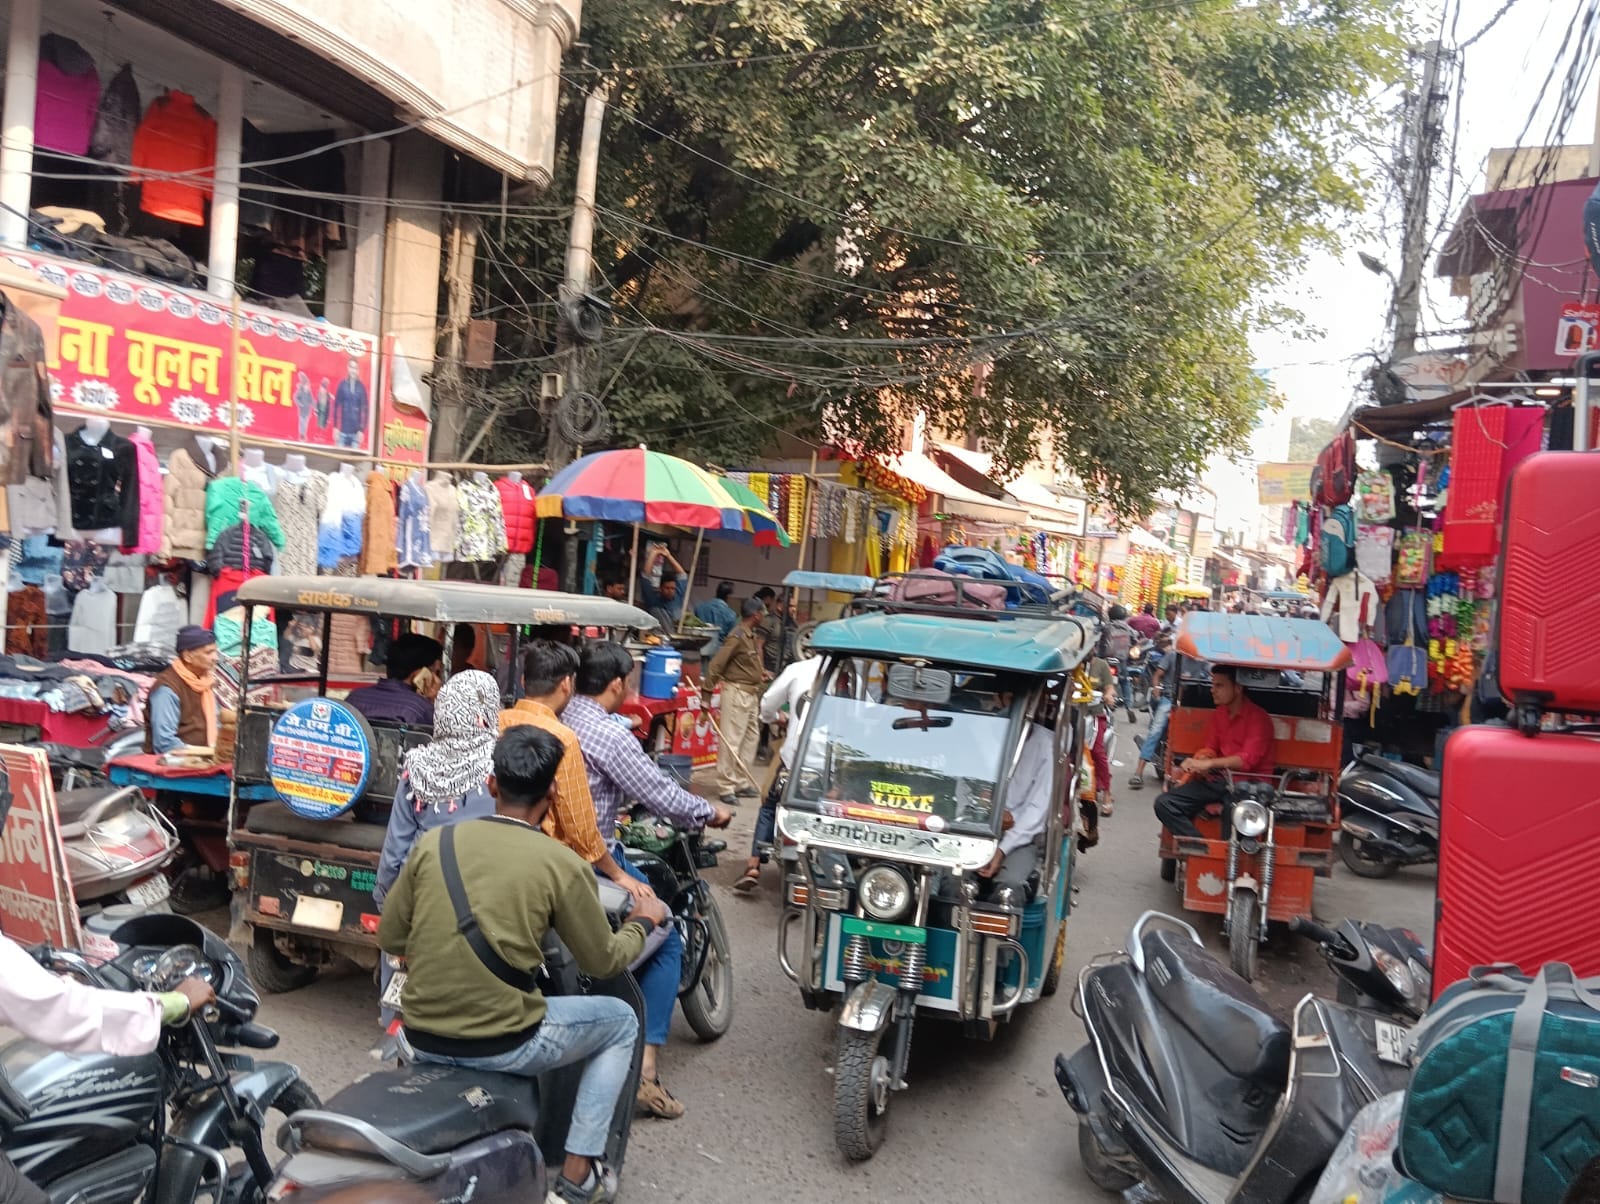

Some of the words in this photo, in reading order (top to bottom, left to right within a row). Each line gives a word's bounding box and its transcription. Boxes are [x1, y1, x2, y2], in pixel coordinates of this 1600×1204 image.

[47, 316, 114, 378] ना
[125, 329, 222, 406] वूलन
[870, 780, 911, 796] SUPER
[874, 791, 935, 813] LUXE
